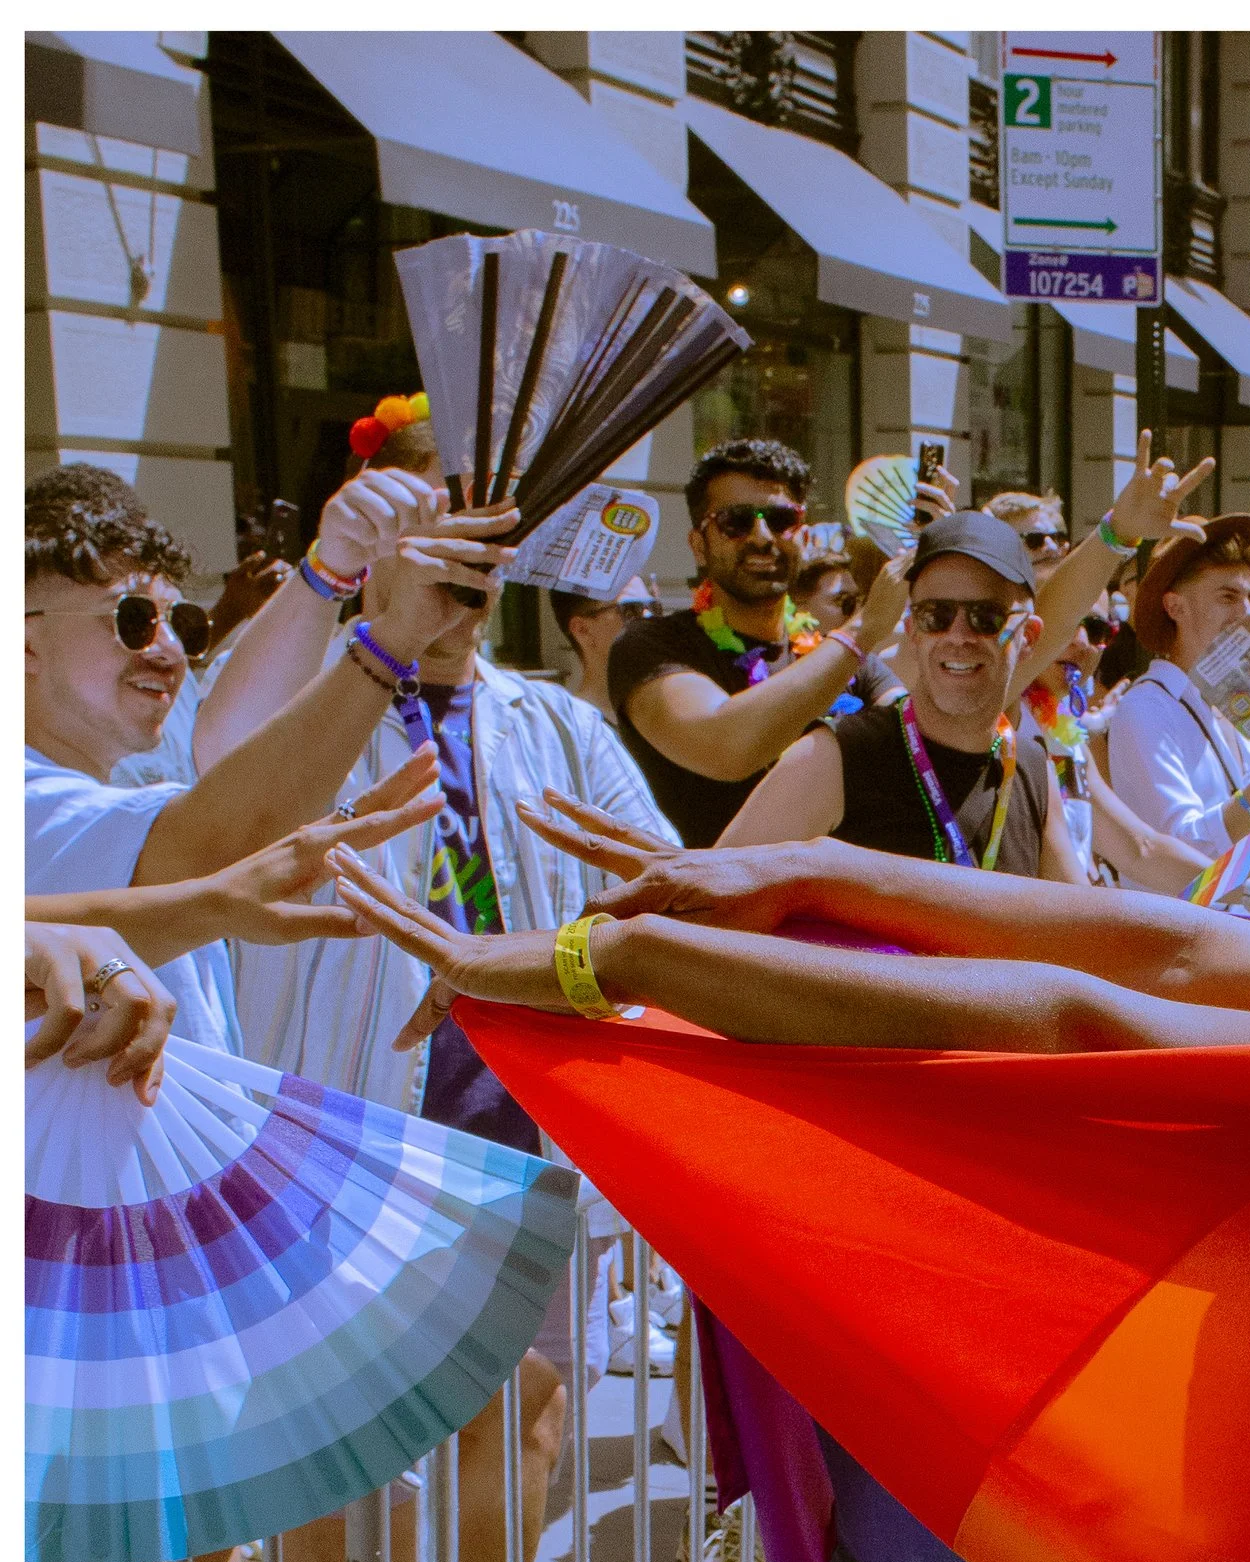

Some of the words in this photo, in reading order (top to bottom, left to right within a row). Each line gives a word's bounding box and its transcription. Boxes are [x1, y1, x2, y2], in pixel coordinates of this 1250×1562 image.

[1015, 78, 1041, 124] 2
[1057, 86, 1084, 98] hour
[1057, 103, 1109, 117] metered
[1058, 120, 1103, 137] parking
[1011, 147, 1042, 164] 8am
[1055, 150, 1092, 168] 10pm
[1011, 167, 1059, 190] Except
[1064, 171, 1113, 194] Sunday
[1029, 269, 1104, 298] 107254
